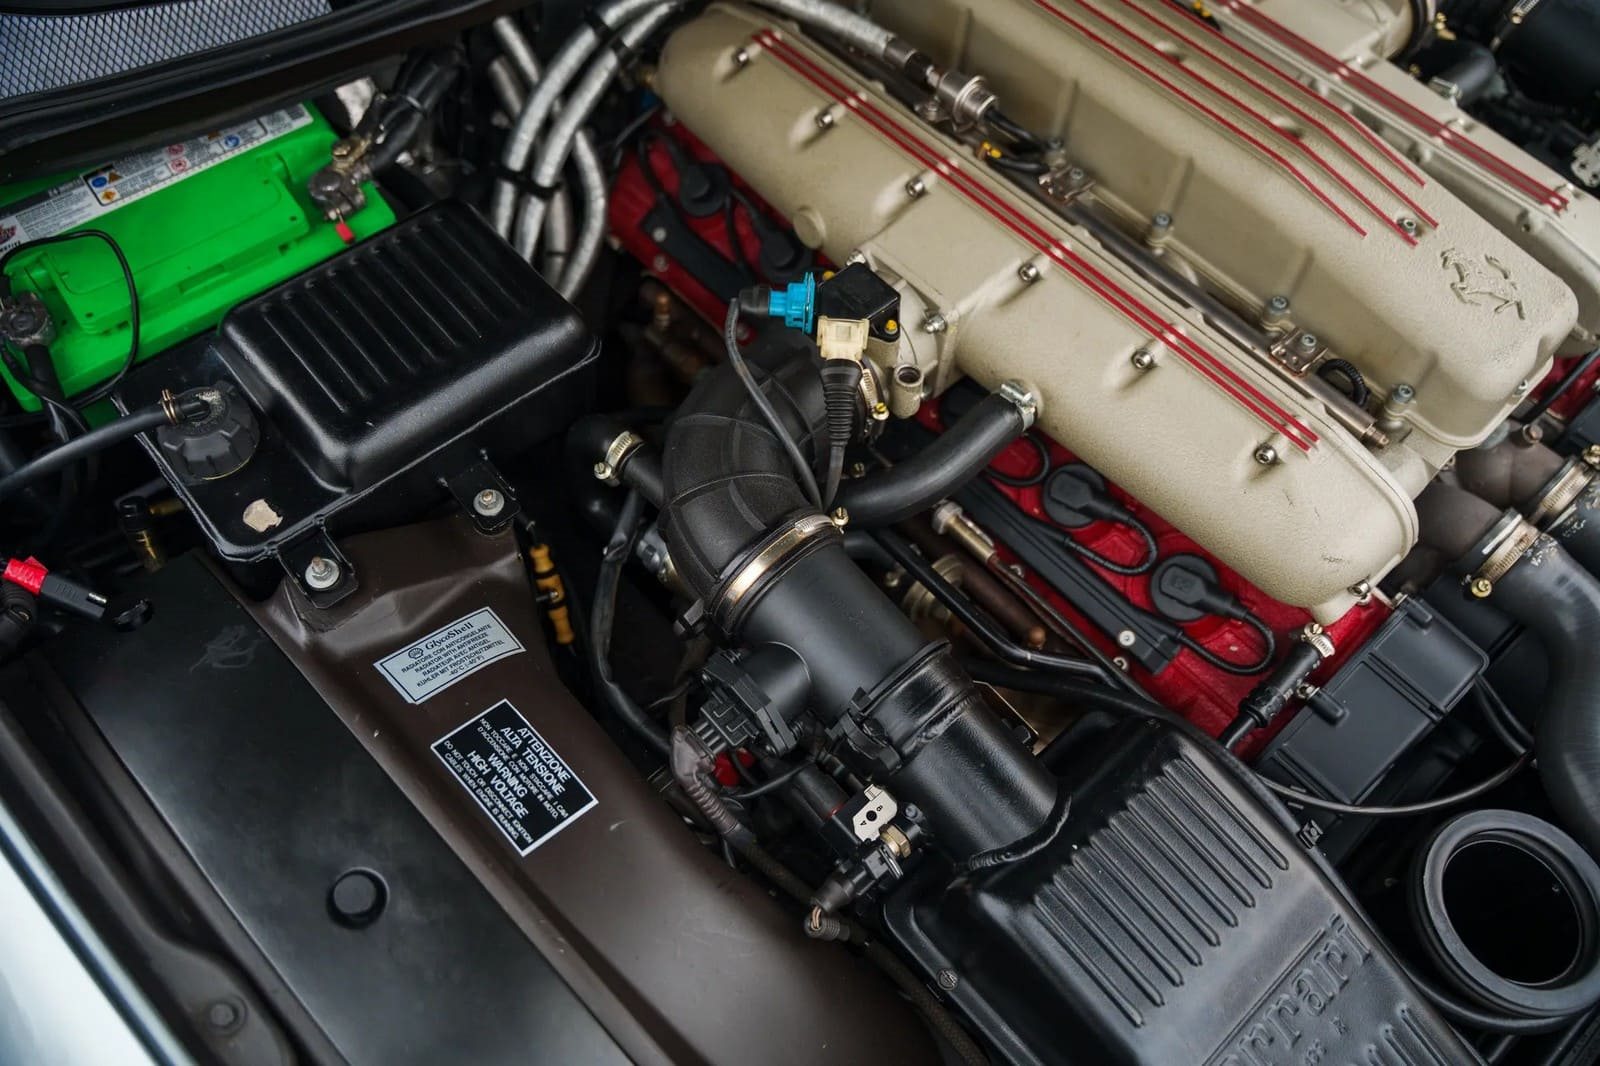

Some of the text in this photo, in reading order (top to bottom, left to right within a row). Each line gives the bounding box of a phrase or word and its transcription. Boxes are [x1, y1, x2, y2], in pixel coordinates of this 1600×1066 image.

[402, 624, 492, 673] RADIATORE CON ANTICONGELANTE
[415, 632, 488, 672] RADIATOR WITH ANTIFREEZE
[422, 638, 490, 676] RADIATEUR AVEC ANTIGEL
[426, 623, 474, 651] GlycoShell
[440, 667, 450, 675] MIT
[450, 640, 504, 669] FROSTSCHUTZMITTEL
[444, 752, 465, 773] CABLES
[462, 772, 478, 789] WHEN
[475, 788, 494, 808] ENGINE
[491, 807, 499, 815] IS
[467, 750, 529, 819] HIGH VOLTAGE
[478, 727, 510, 762] D'ACCENSIONE
[508, 760, 521, 774] CON
[519, 773, 539, 794] MOTORE
[480, 718, 492, 730] NON
[490, 730, 513, 754] TOCCARE
[516, 759, 529, 772] NON
[530, 775, 554, 800] STACCARE
[488, 754, 528, 798] WARNING
[500, 725, 565, 796] ALTA TENSIONE
[518, 727, 571, 783] ATTENZIONE
[444, 740, 534, 843] DO NOT TOUCH OR DISCONNECT IGNITION
[1219, 912, 1371, 1066] rrari
